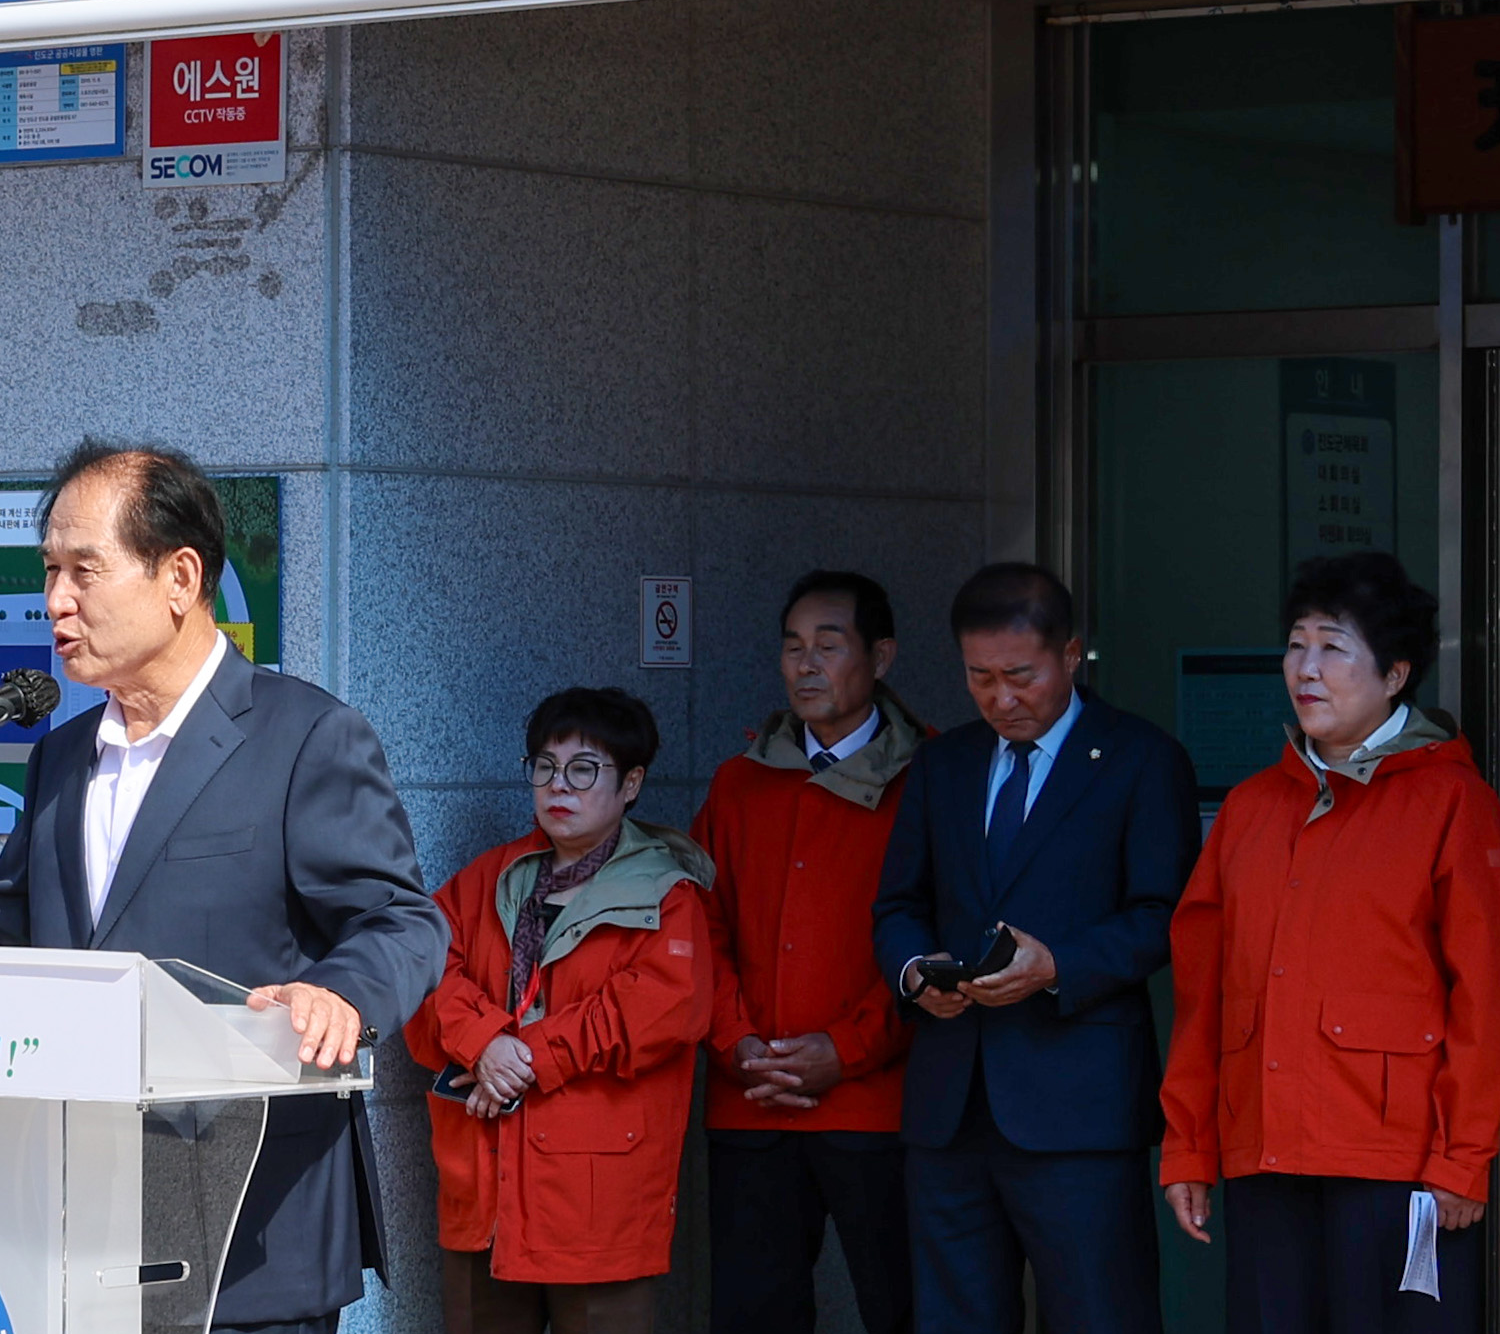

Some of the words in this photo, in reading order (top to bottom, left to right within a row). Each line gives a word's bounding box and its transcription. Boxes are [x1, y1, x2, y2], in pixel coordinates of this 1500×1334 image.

[173, 56, 259, 102] 에스원
[184, 108, 215, 123] CCTV
[216, 107, 247, 122] 작동중
[151, 154, 222, 179] SECOM
[8, 508, 22, 518] 계신
